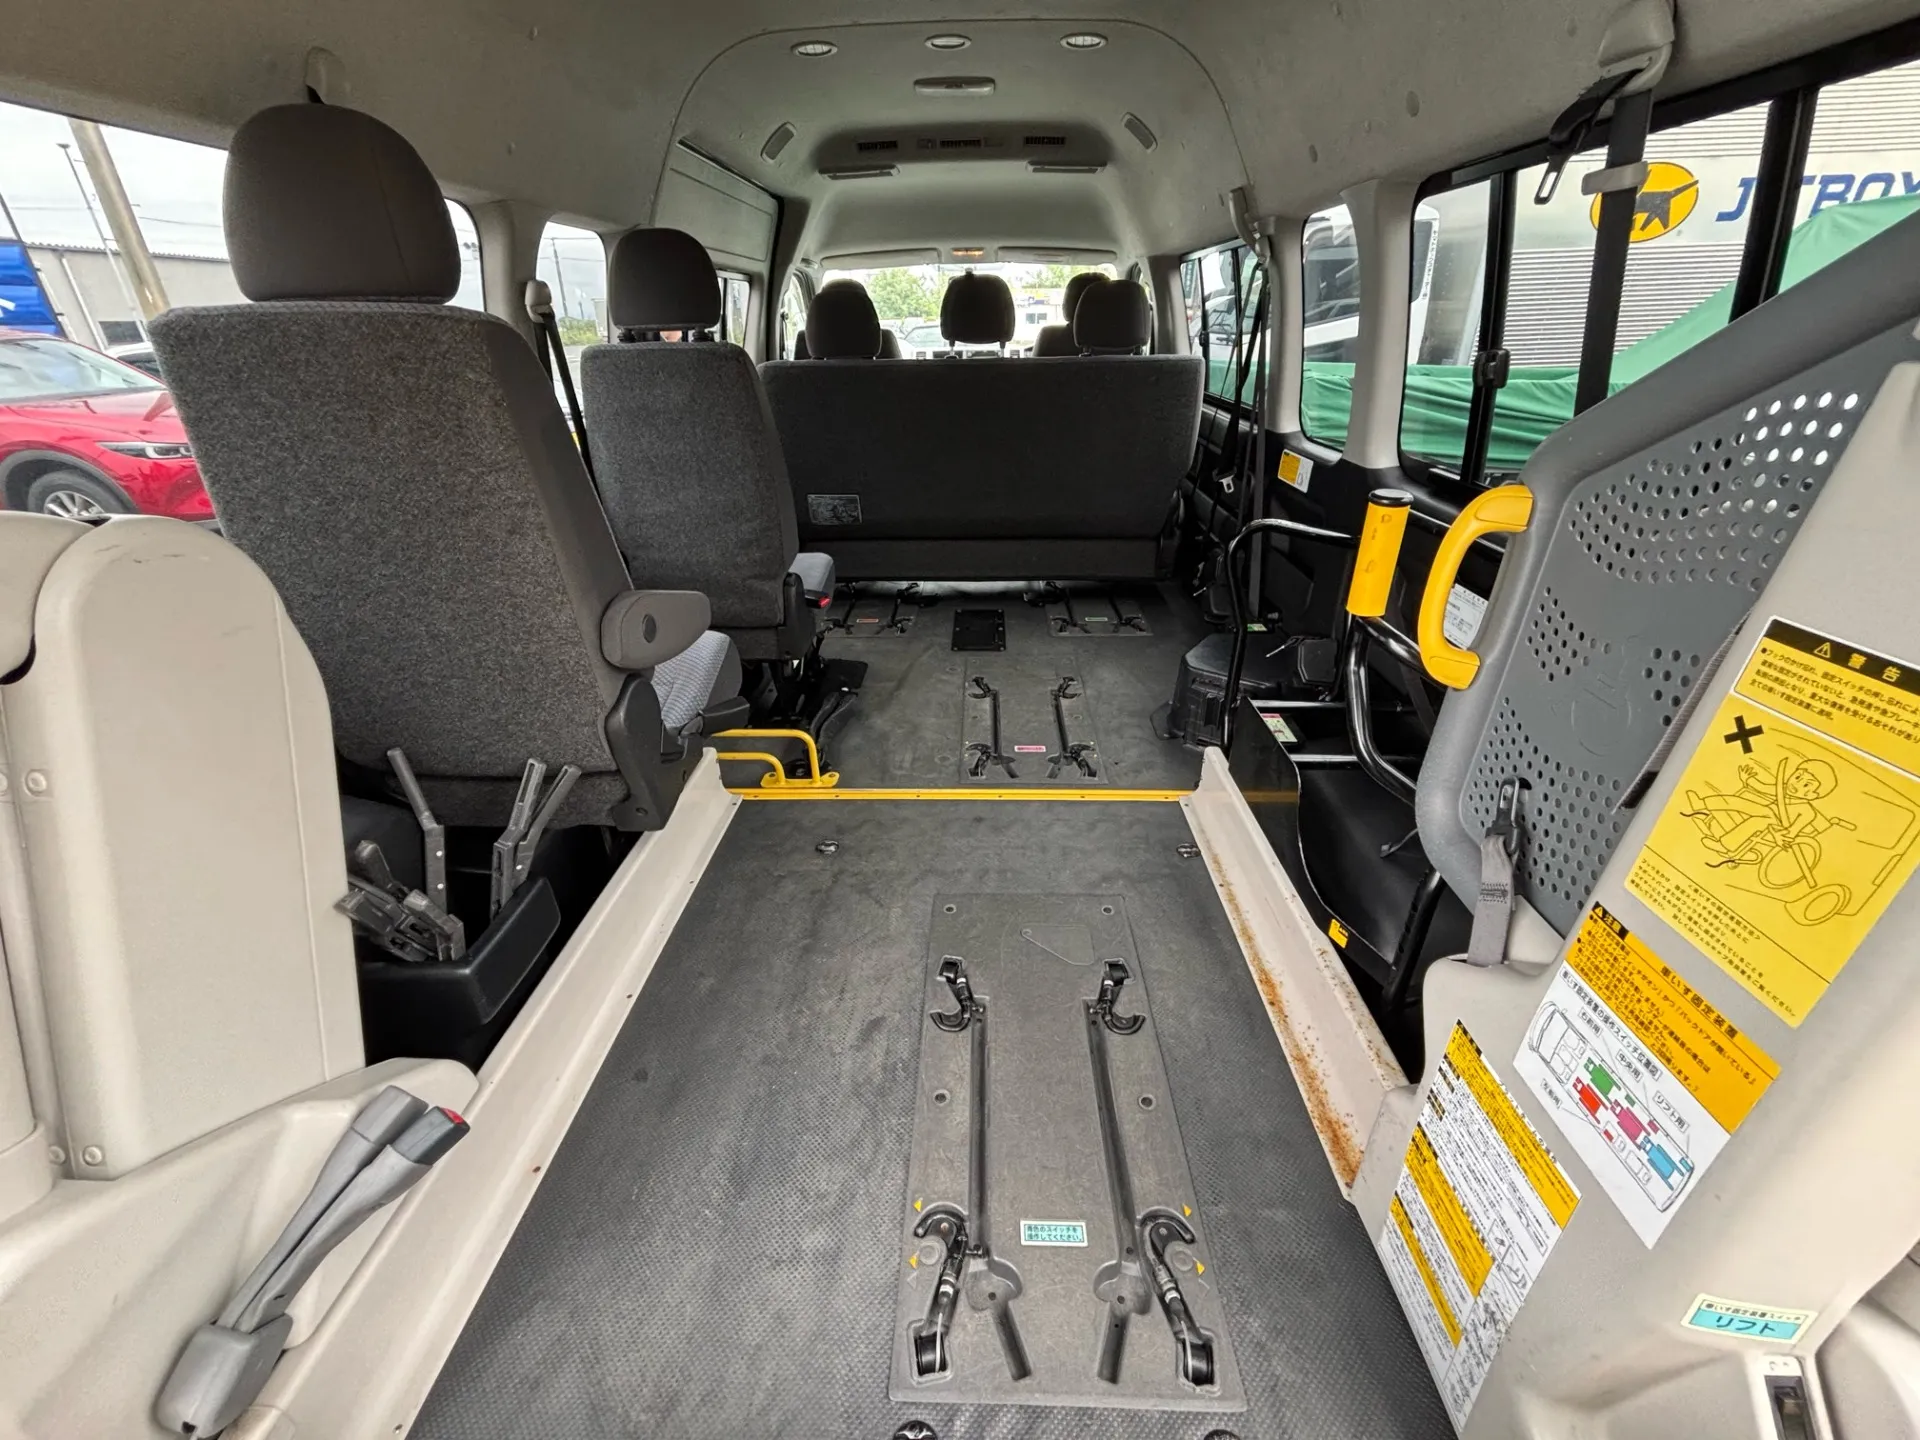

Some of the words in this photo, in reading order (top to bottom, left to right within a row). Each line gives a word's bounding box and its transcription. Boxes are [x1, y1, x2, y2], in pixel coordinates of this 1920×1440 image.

[1661, 965, 1738, 1040] 車いす固定装置
[1656, 1095, 1686, 1130] リフト用
[1716, 1315, 1776, 1334] リフト
